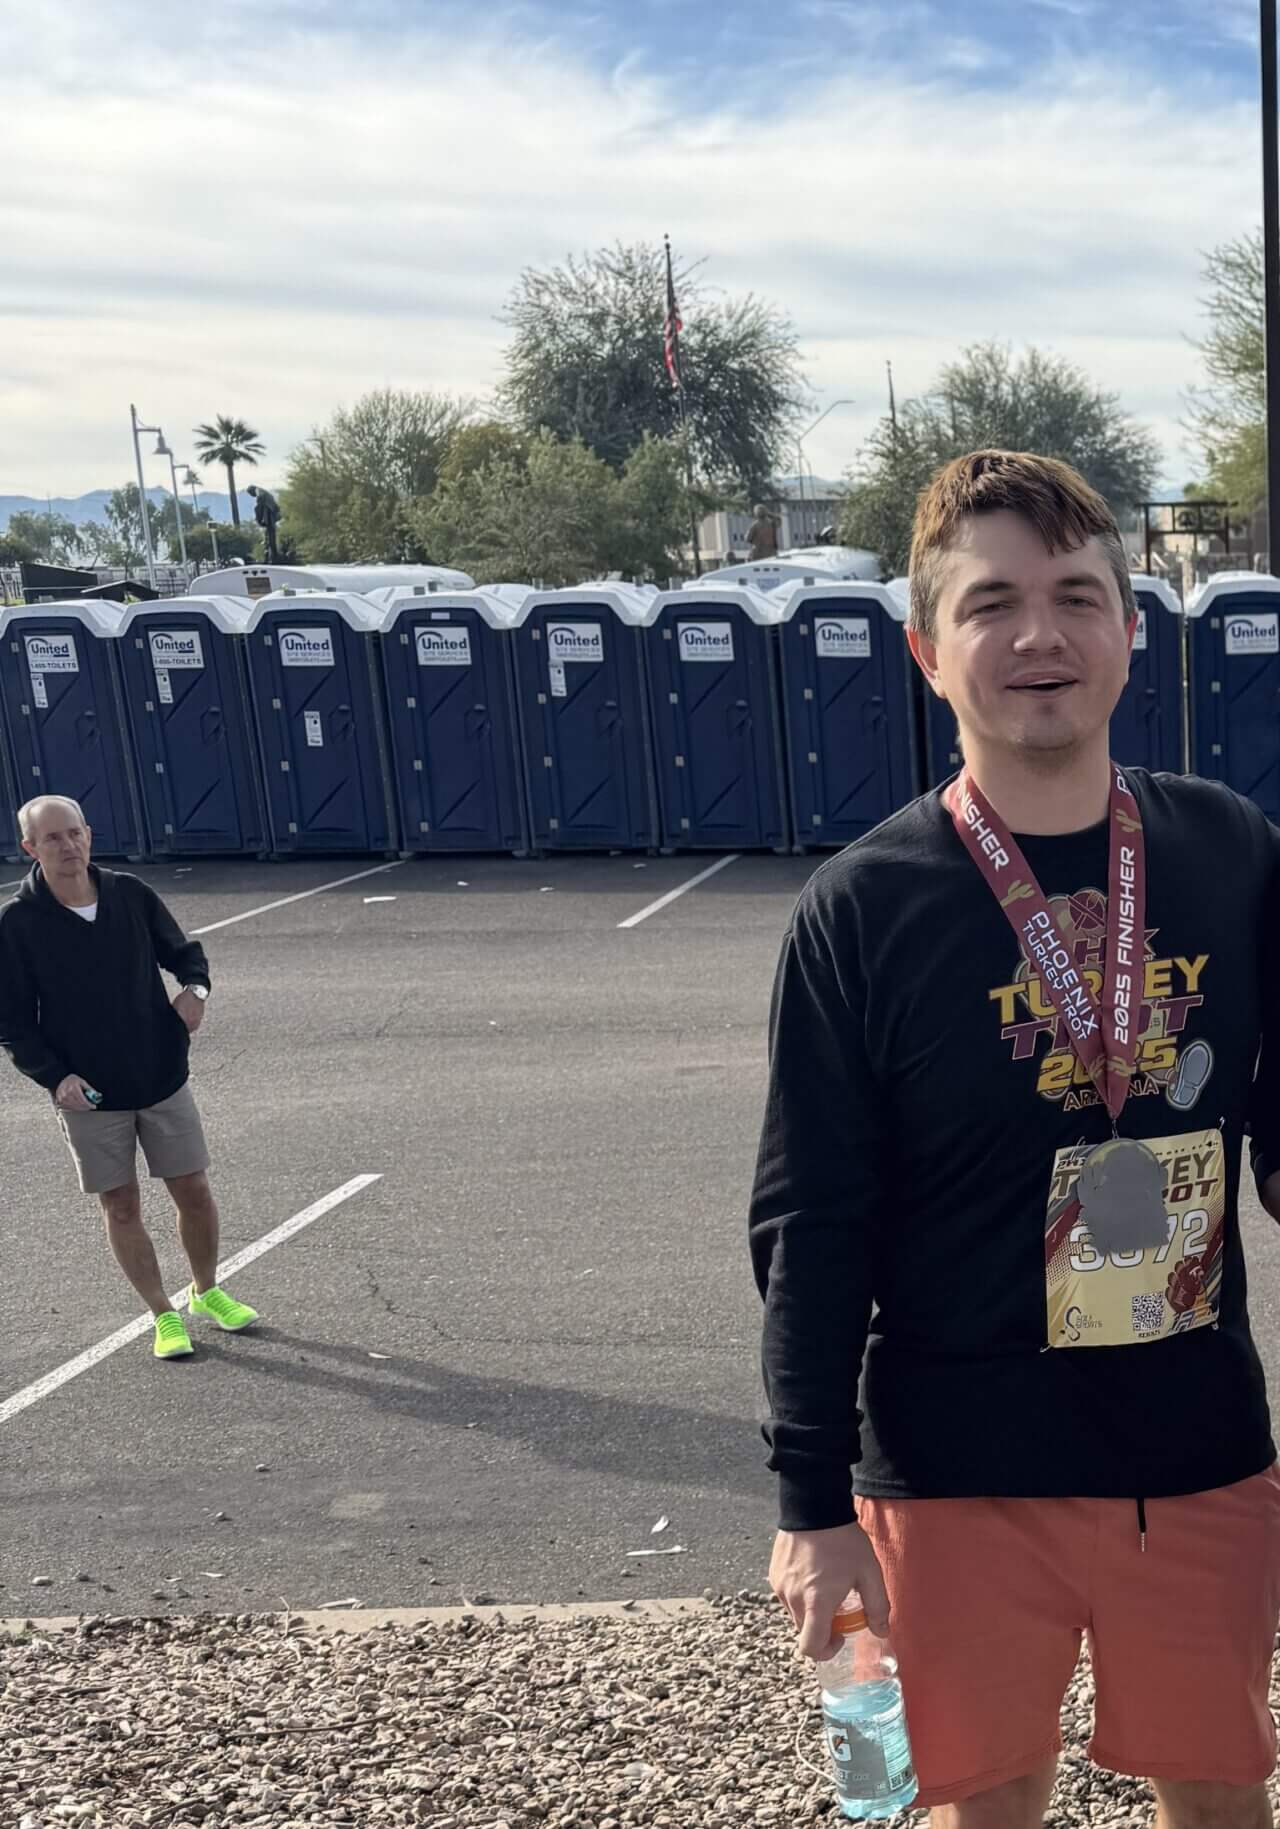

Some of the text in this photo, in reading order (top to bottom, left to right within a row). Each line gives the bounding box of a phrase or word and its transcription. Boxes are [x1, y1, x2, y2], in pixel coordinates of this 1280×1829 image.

[822, 629, 867, 641] United
[1231, 625, 1276, 639] United
[156, 638, 194, 650] United
[285, 638, 329, 650] United
[421, 637, 467, 650] United
[554, 634, 600, 646] United
[685, 634, 729, 646] United
[31, 642, 69, 654] United
[1115, 846, 1135, 1044] 2025 FINISHER
[1032, 911, 1099, 1035] PHOENIX
[1022, 920, 1089, 1040] TURKEY TROT
